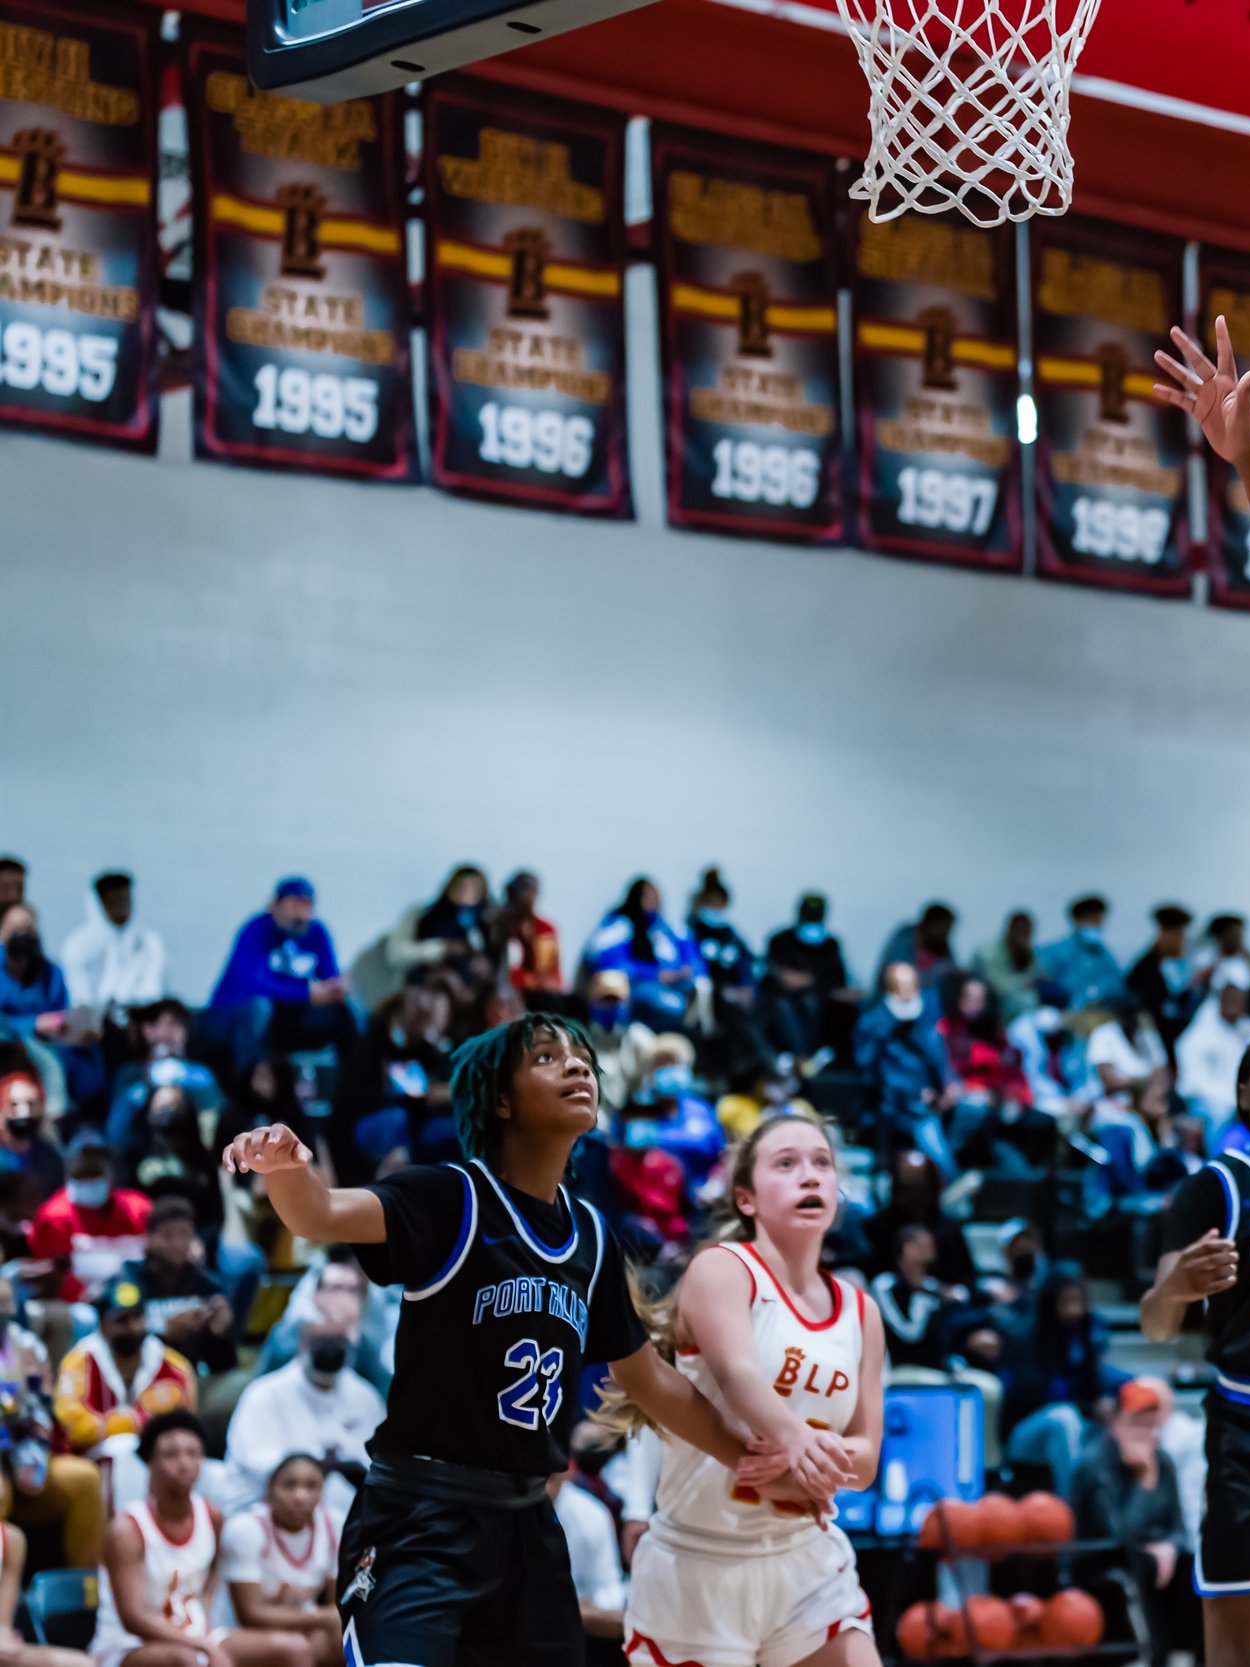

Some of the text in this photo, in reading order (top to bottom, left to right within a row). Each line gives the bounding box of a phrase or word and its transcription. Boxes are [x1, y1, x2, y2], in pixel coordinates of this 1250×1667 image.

[0, 321, 118, 402] 995
[253, 363, 379, 443] 1995
[479, 402, 595, 479] 1996
[711, 438, 821, 509] 1996
[897, 466, 998, 536] 1997
[472, 1276, 547, 1326] PORT
[497, 1337, 564, 1432] 23
[773, 1356, 850, 1398] BLP
